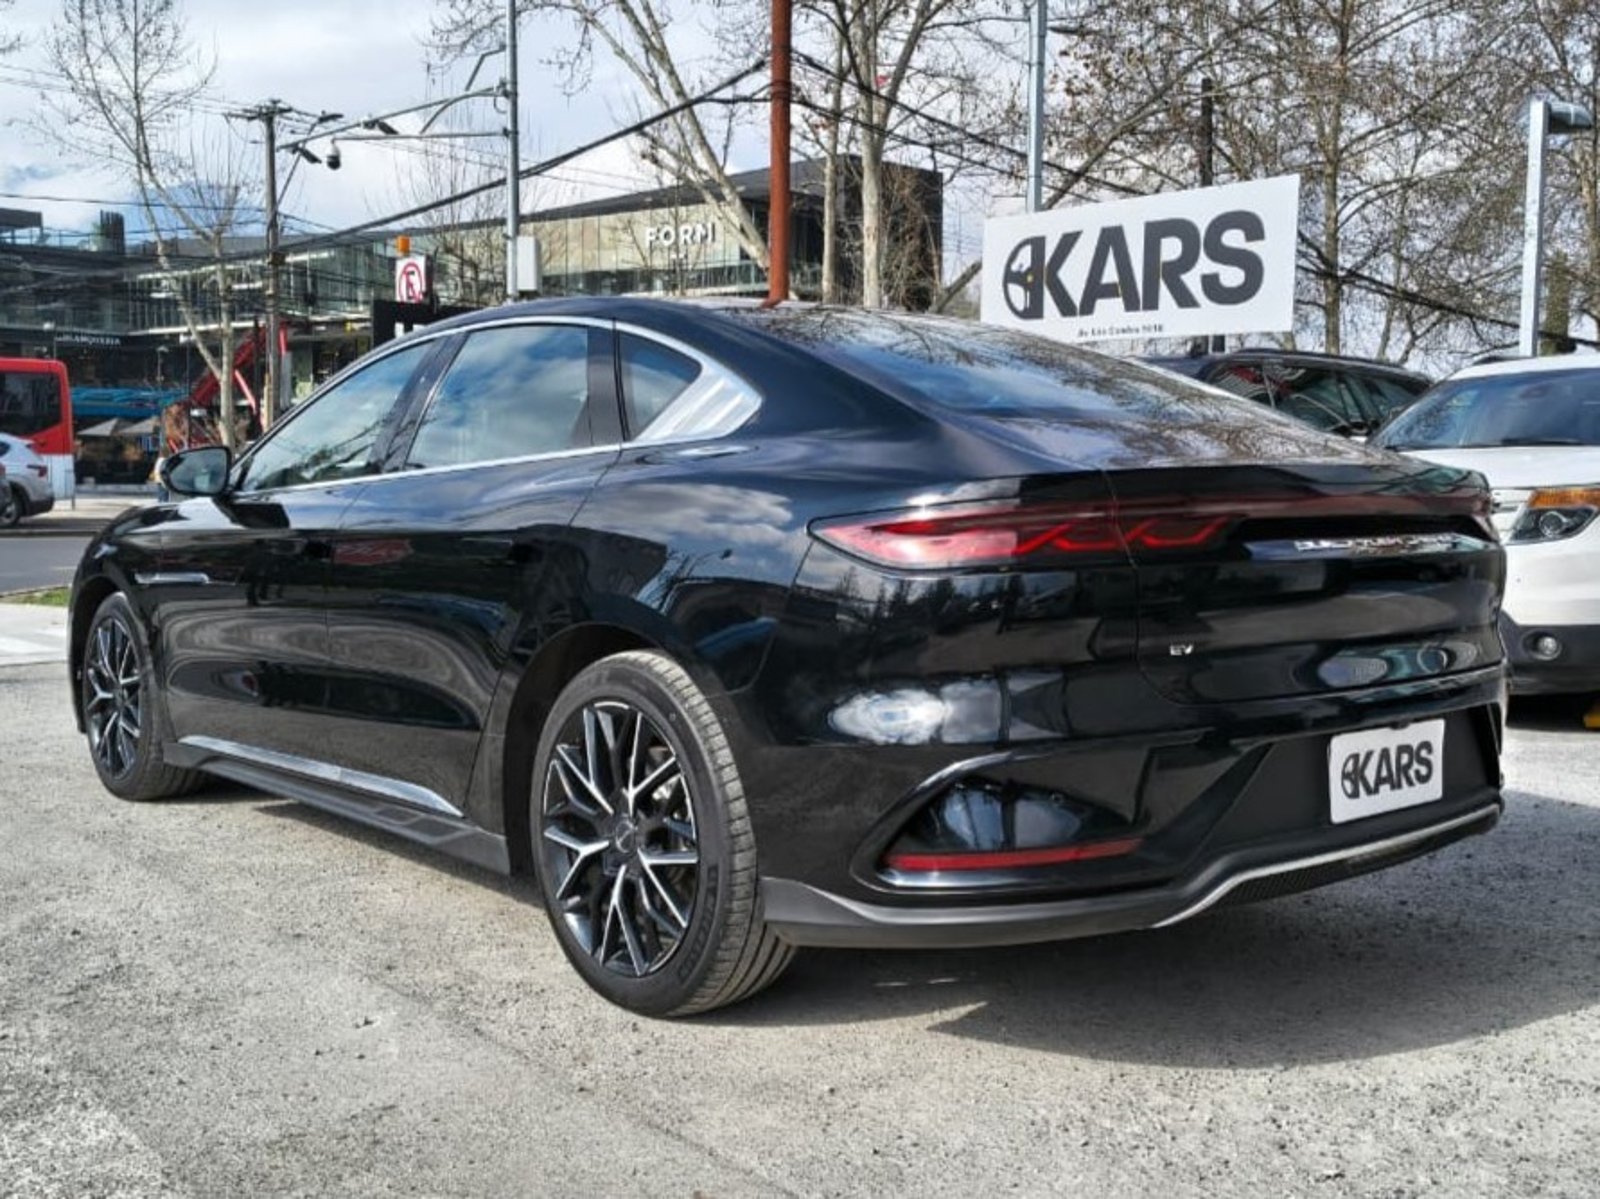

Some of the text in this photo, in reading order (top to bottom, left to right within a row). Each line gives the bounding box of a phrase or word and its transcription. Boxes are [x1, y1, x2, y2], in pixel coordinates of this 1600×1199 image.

[1045, 210, 1265, 318] KARS
[1170, 644, 1193, 656] EV
[1360, 740, 1433, 797] KARS
